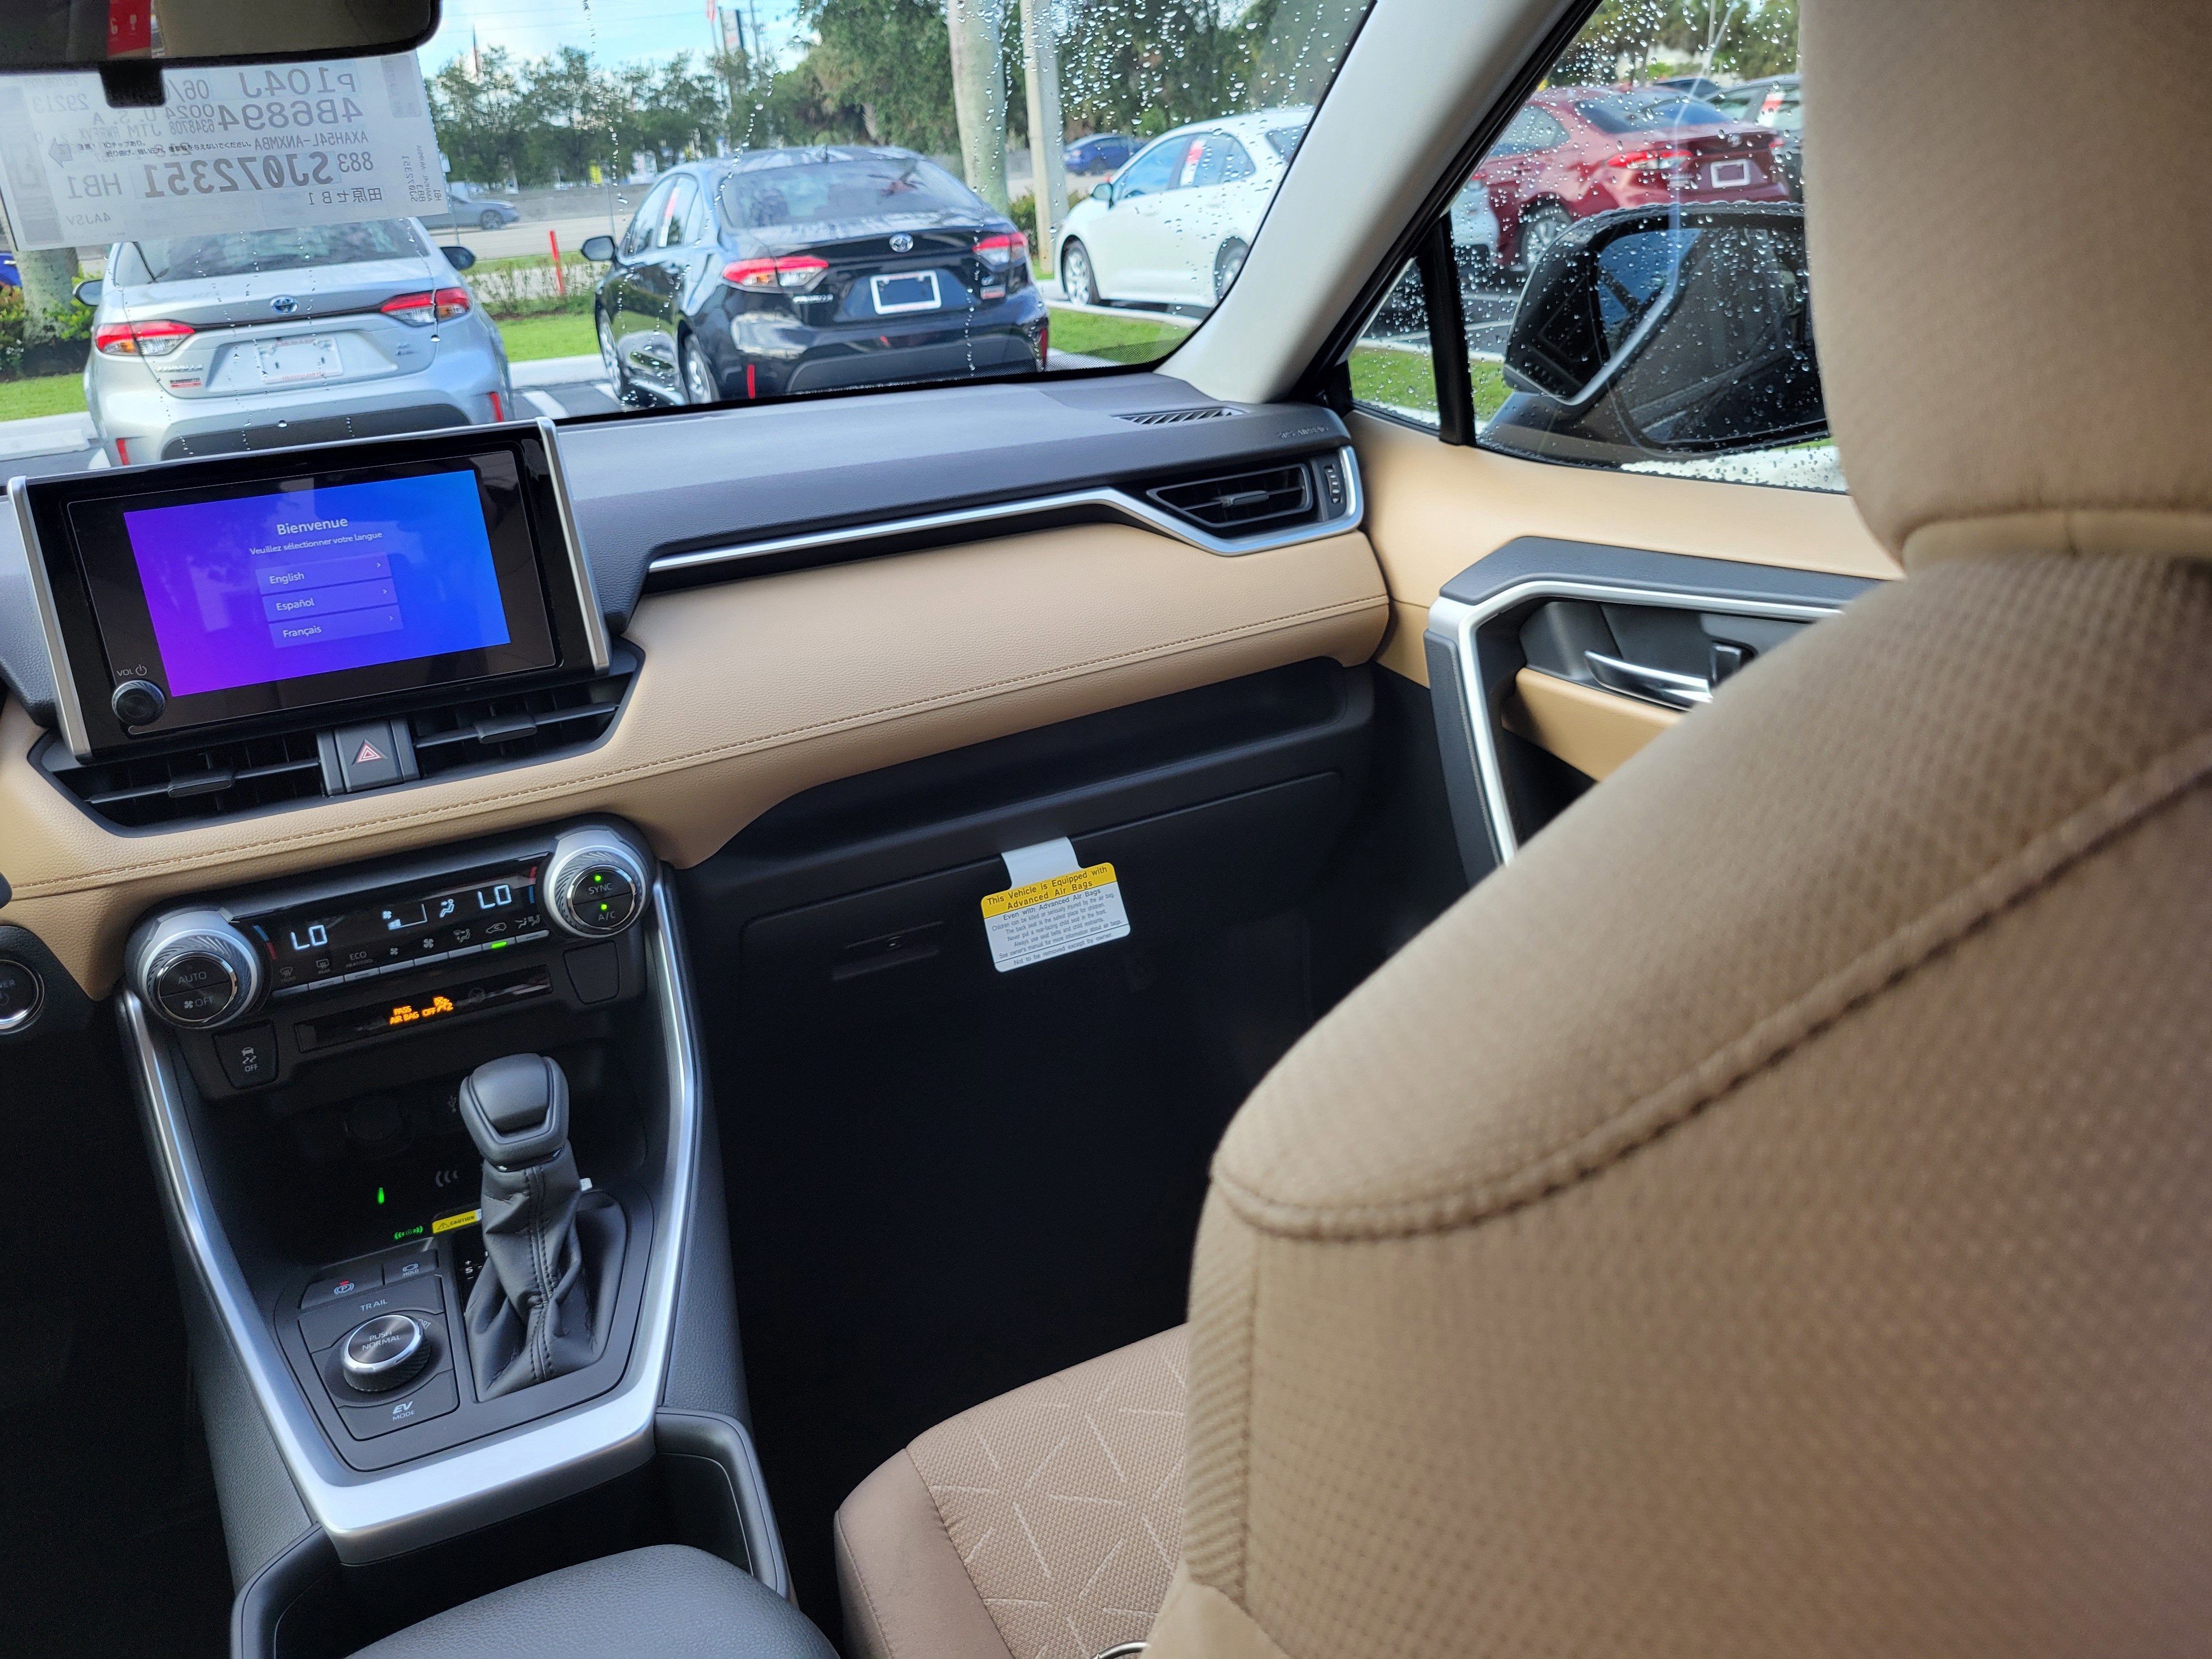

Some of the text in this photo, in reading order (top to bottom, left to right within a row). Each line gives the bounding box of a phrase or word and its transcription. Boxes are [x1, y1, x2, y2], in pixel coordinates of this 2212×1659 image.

[276, 517, 348, 535] Bienvenue
[250, 532, 383, 555] Veuillez sélectionner votre langue
[269, 572, 305, 584] English
[276, 598, 315, 611] Español
[283, 625, 322, 638] Français
[589, 883, 613, 895] SYNC
[987, 895, 1005, 905] This
[1008, 887, 1037, 899] Vehicle
[1052, 871, 1087, 887] Equipped
[1091, 866, 1108, 876] with
[477, 884, 512, 910] LO
[1008, 881, 1092, 910] Advanced Air Bags
[1003, 912, 1019, 921] Even
[1022, 907, 1036, 915] with
[1039, 897, 1069, 910] Advanced
[1085, 889, 1101, 898] Bags
[598, 911, 616, 921] A/C
[992, 922, 1009, 931] Children
[290, 924, 328, 950] LO
[349, 951, 366, 960] ECO
[1043, 946, 1065, 956] removed
[178, 972, 207, 984] AUTO
[195, 996, 213, 1007] OFF
[390, 1007, 436, 1025] AIR BAG OFF
[393, 1006, 411, 1015] PASS
[450, 1215, 475, 1226] CAUTION
[403, 1268, 419, 1277] HOLD
[360, 1299, 388, 1312] TRAIL
[369, 1330, 393, 1341] PUSH
[362, 1335, 401, 1352] NORMAL
[392, 1401, 414, 1414] EV
[393, 1409, 415, 1421] MODE
